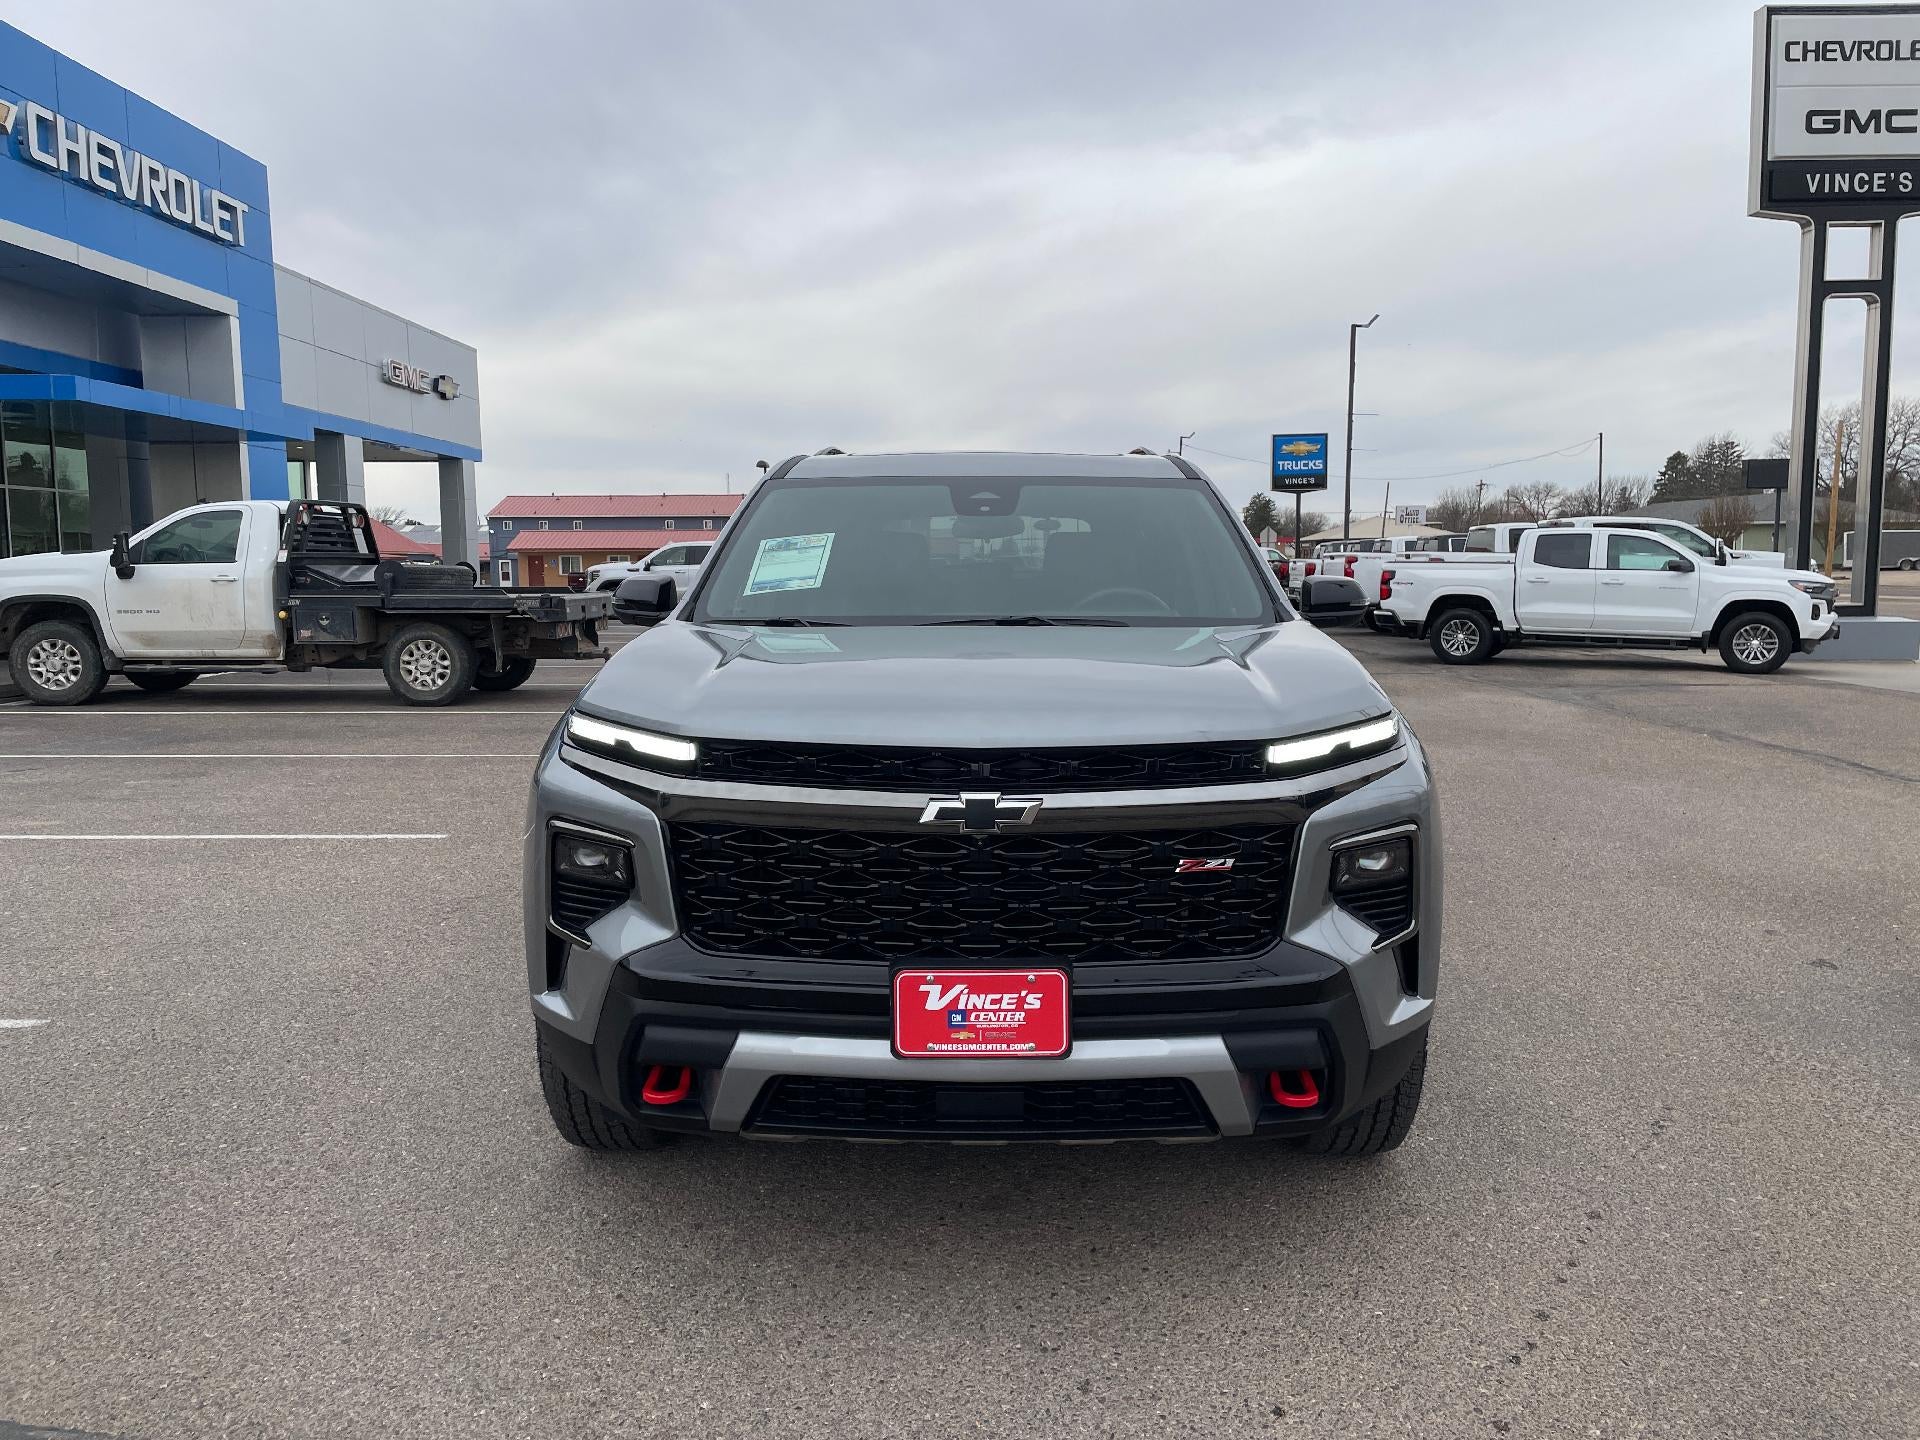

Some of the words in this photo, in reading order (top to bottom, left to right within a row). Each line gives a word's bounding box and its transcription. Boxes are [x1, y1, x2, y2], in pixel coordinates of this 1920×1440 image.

[1805, 109, 1918, 134] GMC
[19, 100, 248, 247] CHEVROLET
[1806, 172, 1913, 193] VINCE'S
[383, 359, 431, 394] GMC
[1278, 460, 1323, 471] TRUCKS
[1285, 477, 1315, 485] VINCE'S
[1400, 515, 1419, 524] OFFICE
[1175, 858, 1235, 872] Z71
[970, 1011, 1026, 1022] CENTER
